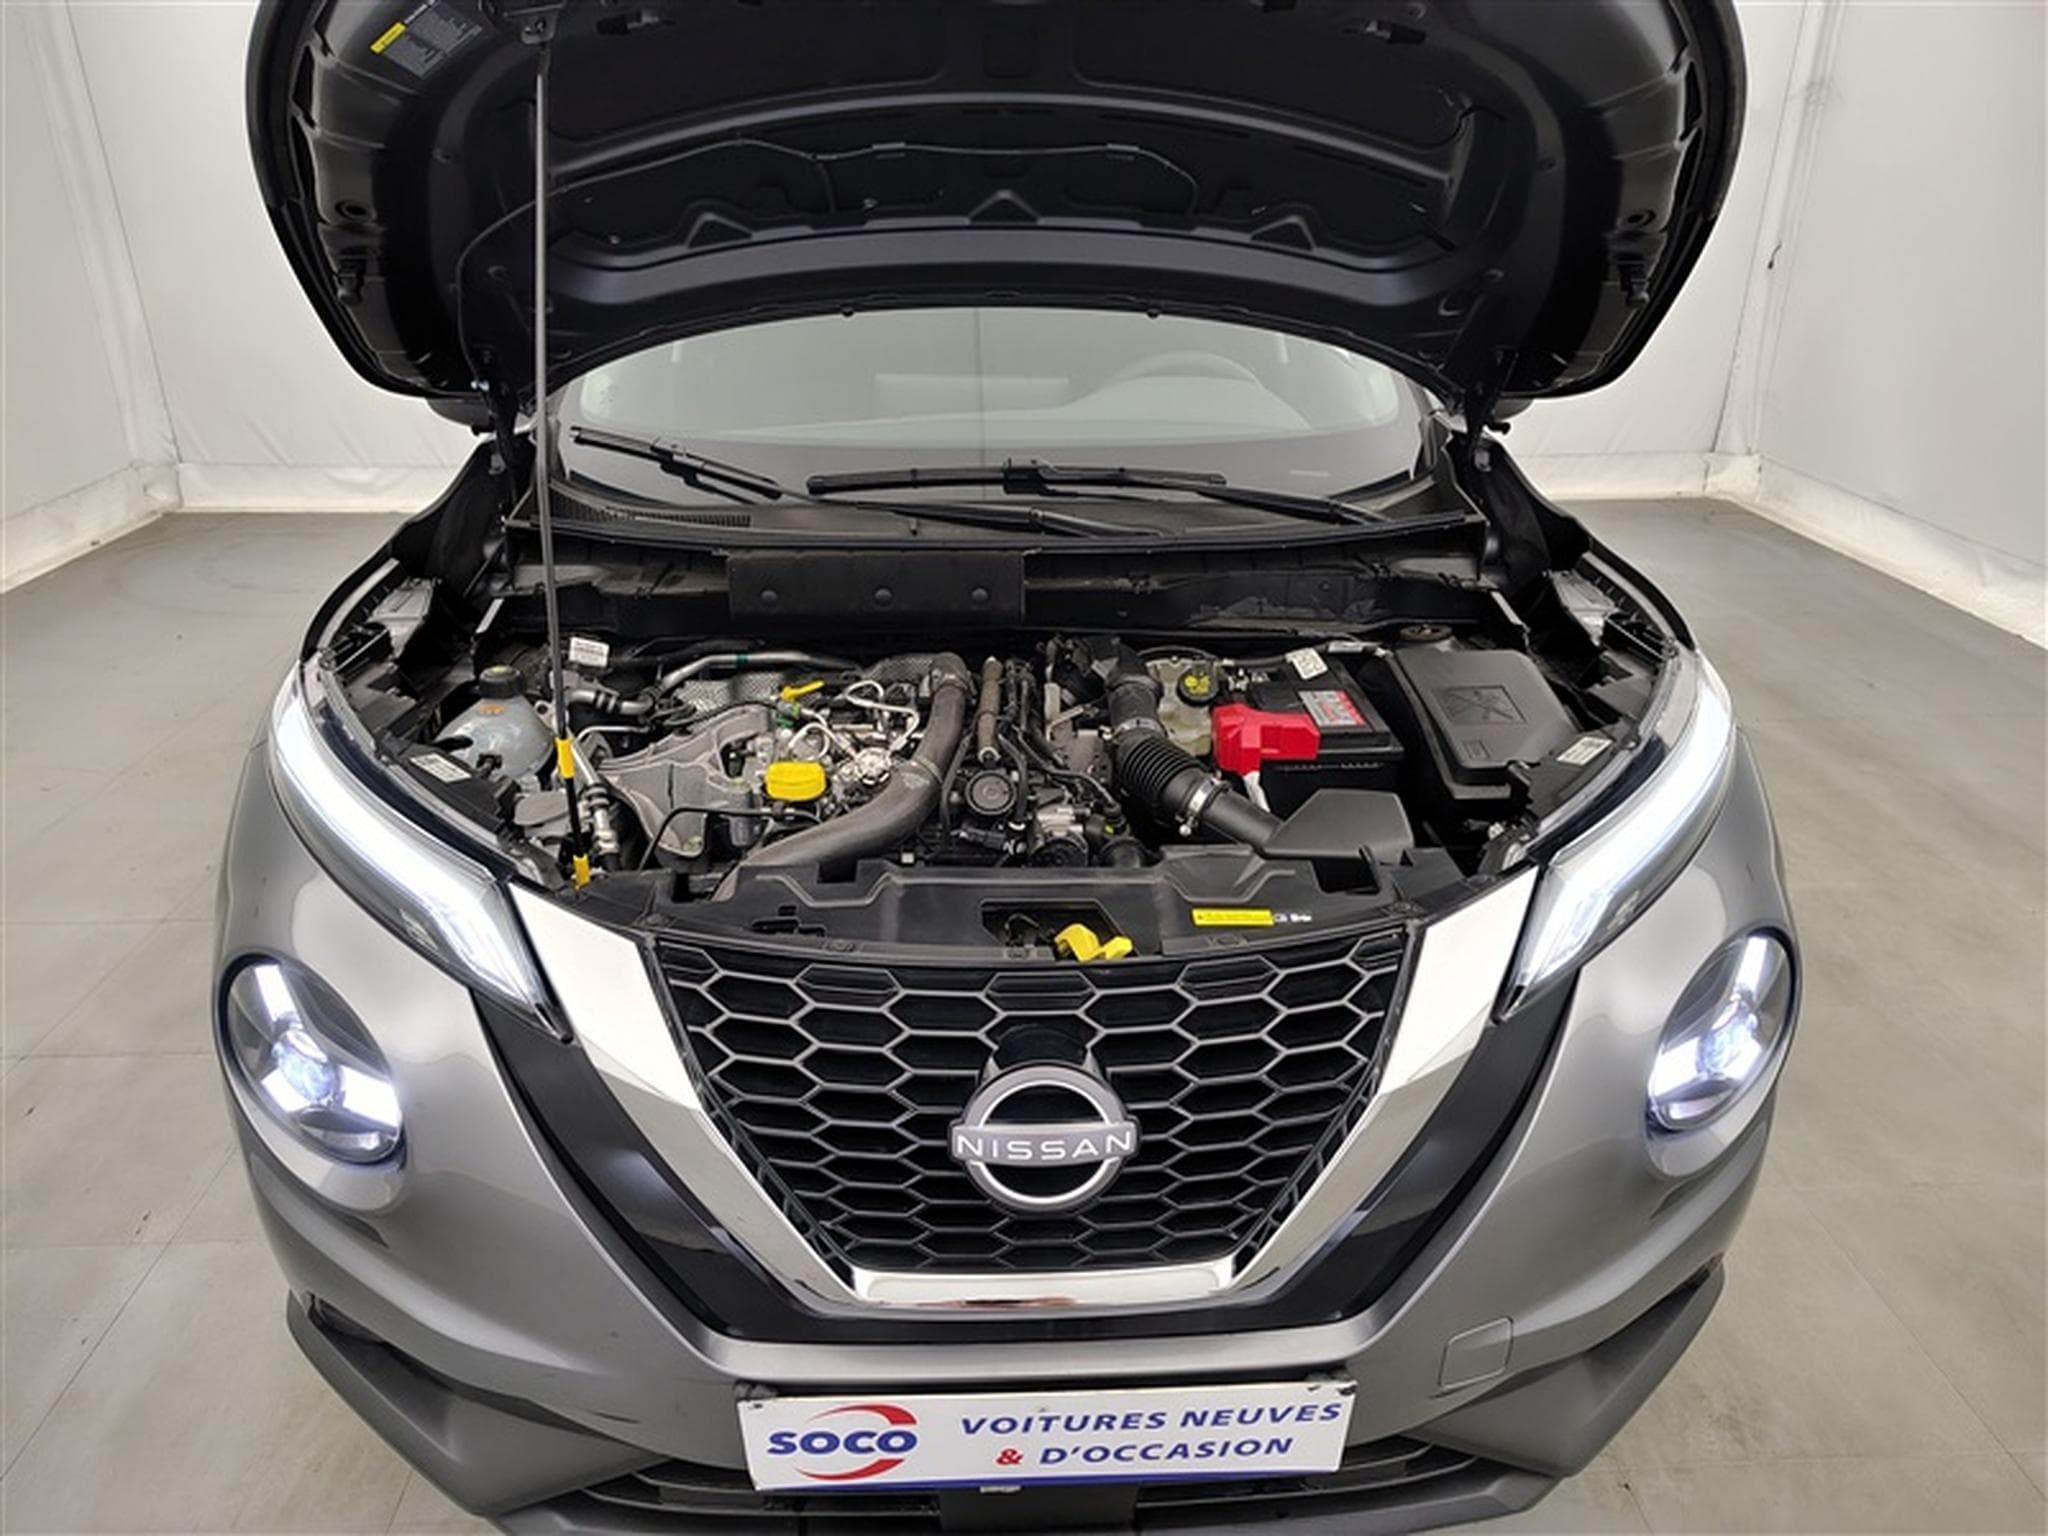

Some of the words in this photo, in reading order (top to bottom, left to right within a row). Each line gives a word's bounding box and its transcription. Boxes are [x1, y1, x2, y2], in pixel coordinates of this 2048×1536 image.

[957, 1131, 1131, 1160] NISSAN
[962, 1412, 1166, 1434] VOITURES
[1180, 1403, 1342, 1428] NEUVES
[768, 1430, 918, 1455] SOCO
[996, 1448, 1023, 1466] &
[1039, 1437, 1294, 1465] D'OCCASION
